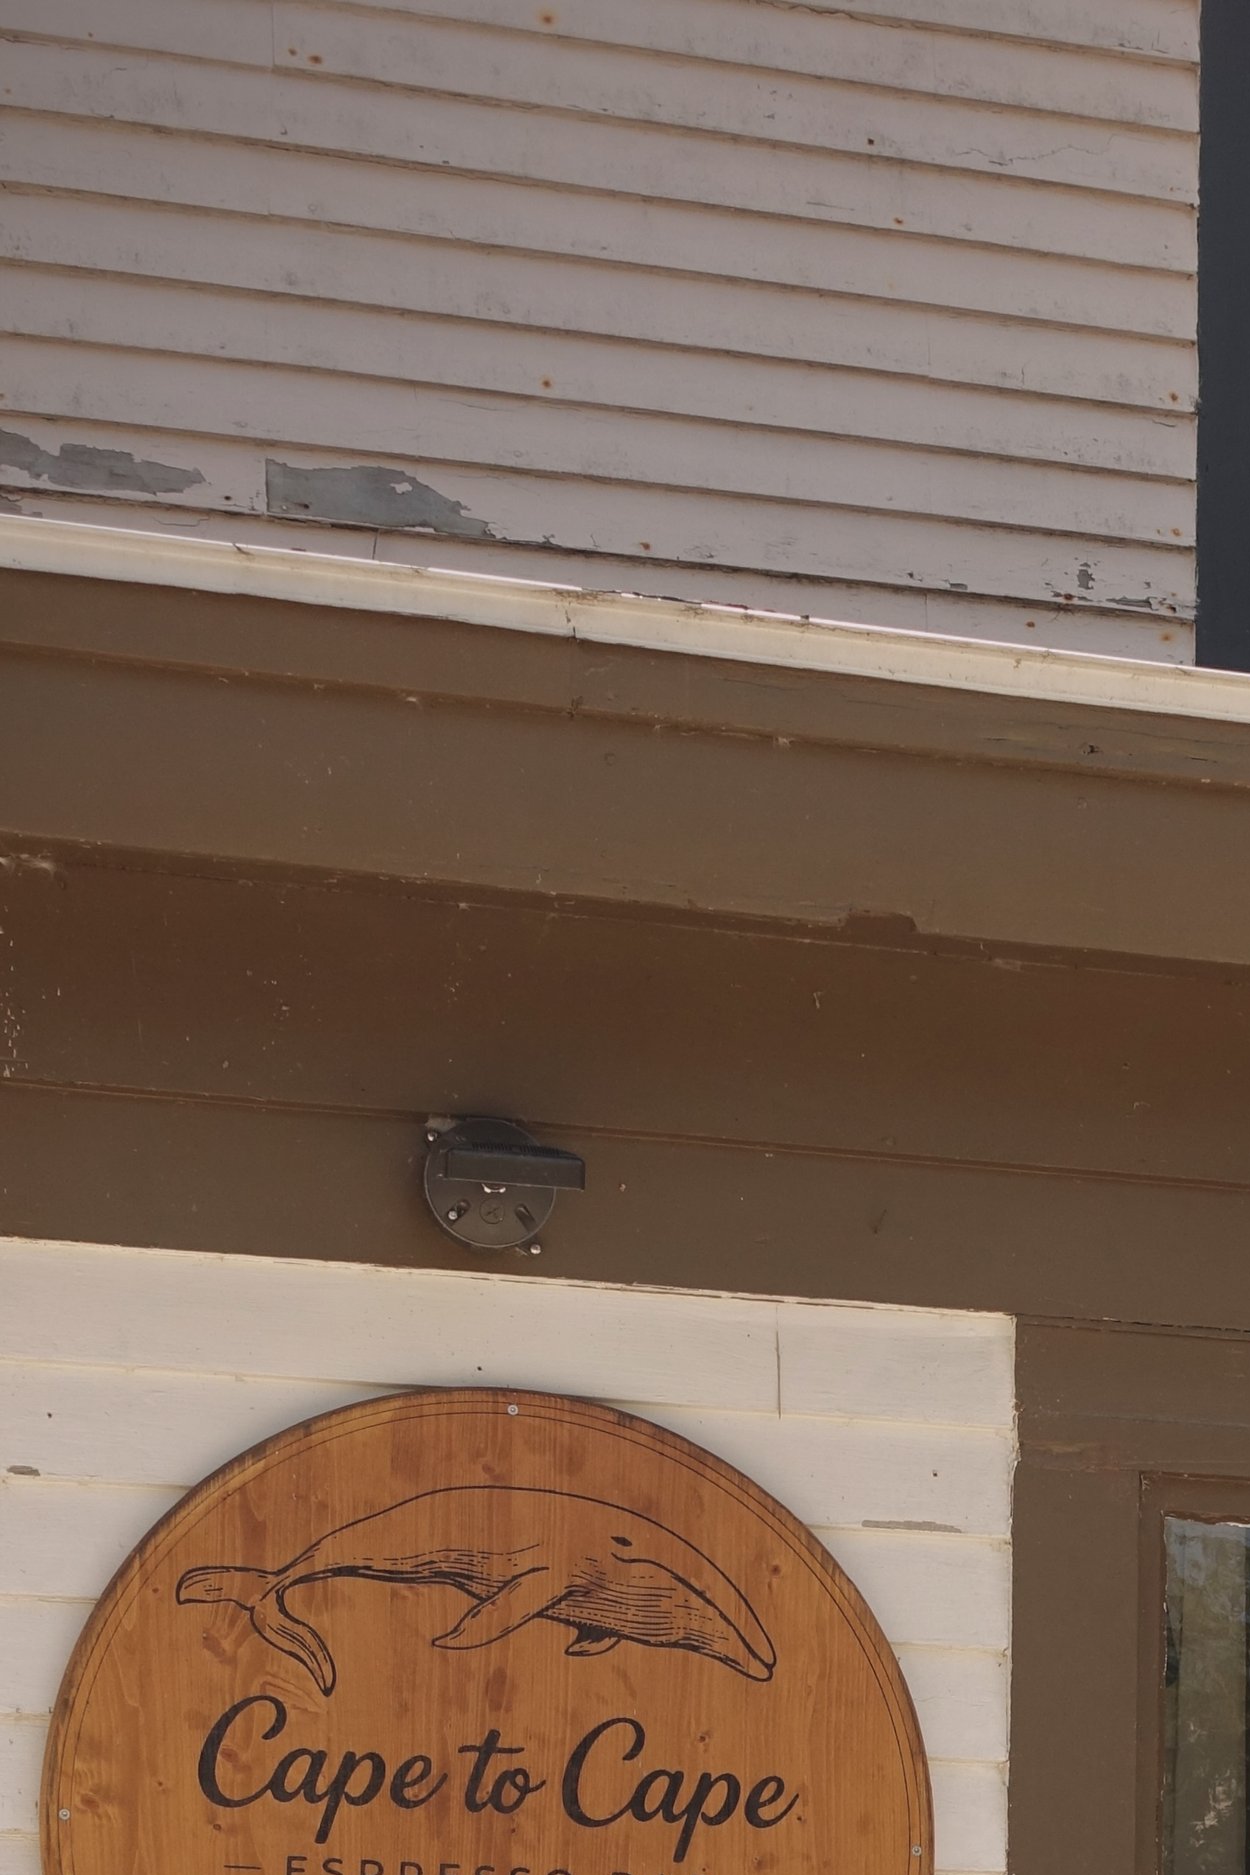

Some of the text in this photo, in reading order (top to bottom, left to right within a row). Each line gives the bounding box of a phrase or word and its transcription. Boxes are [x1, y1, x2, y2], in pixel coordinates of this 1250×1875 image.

[198, 1694, 801, 1863] Cape to Cape
